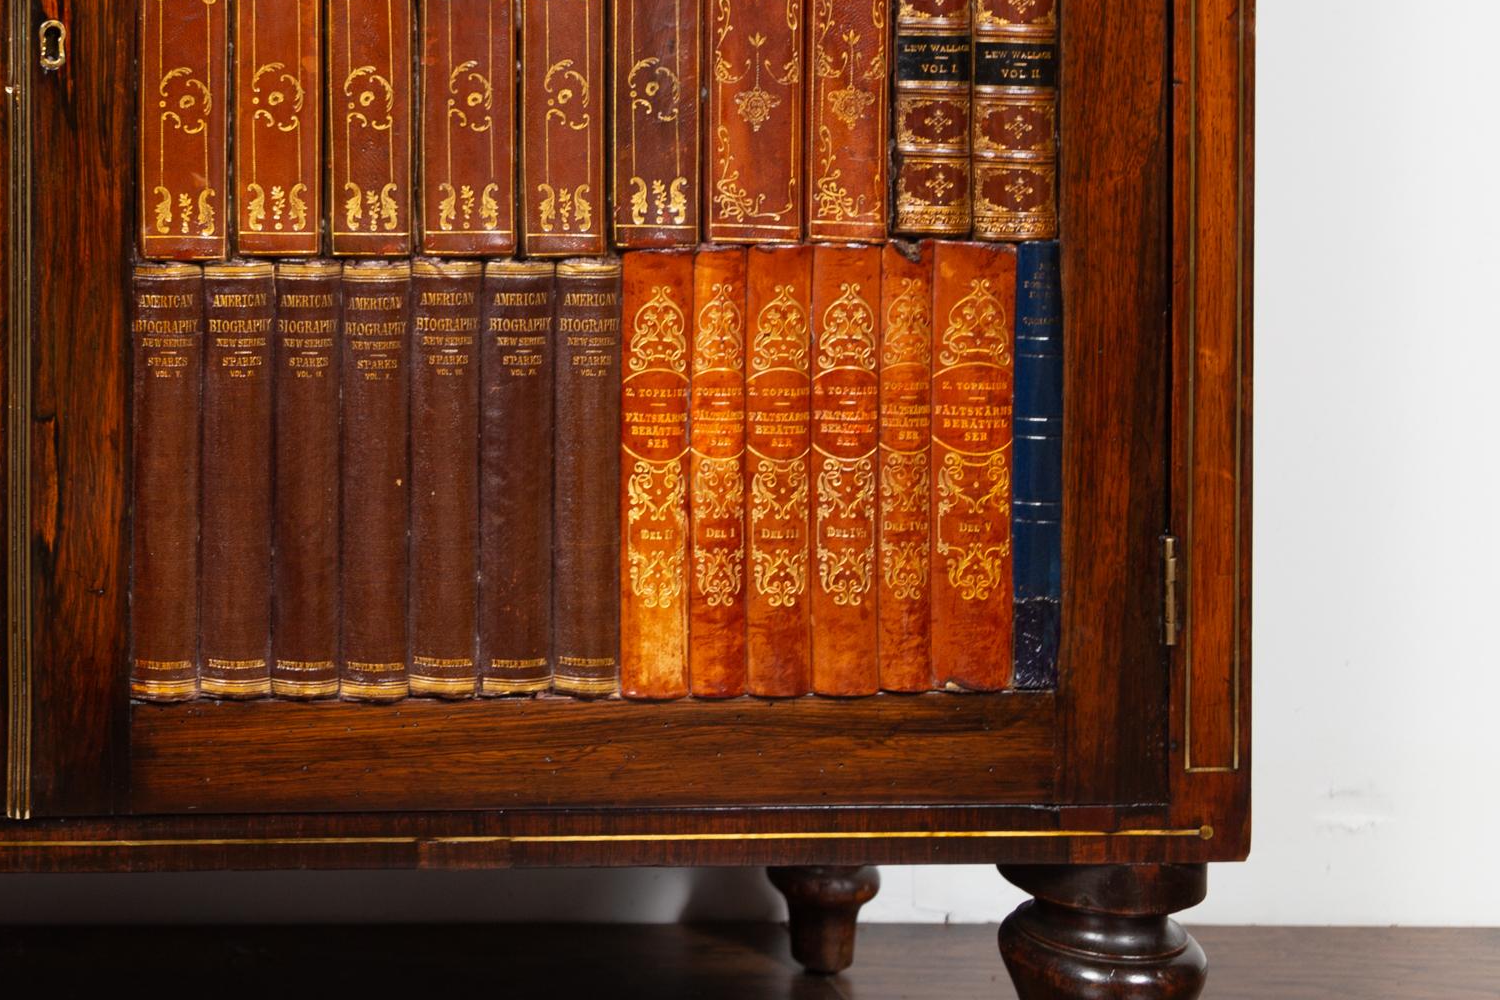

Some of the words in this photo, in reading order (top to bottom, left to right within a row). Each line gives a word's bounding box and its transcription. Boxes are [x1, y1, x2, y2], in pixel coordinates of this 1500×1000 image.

[904, 45, 927, 53] LEW
[985, 51, 1007, 59] LEW
[138, 294, 194, 308] AMERICAN
[212, 294, 267, 308] AMERICAN
[420, 292, 475, 306] AMERICAN
[135, 319, 198, 334] BIOGRAPHY
[209, 319, 272, 333] BIOGRAPHY
[415, 317, 479, 332] BIOGRAPHY
[142, 338, 161, 348] NEW
[148, 357, 188, 367] SPARKS
[222, 356, 262, 367] SPARKS
[428, 355, 469, 366] SPARKS
[964, 433, 988, 442] SER
[647, 439, 669, 448] SER
